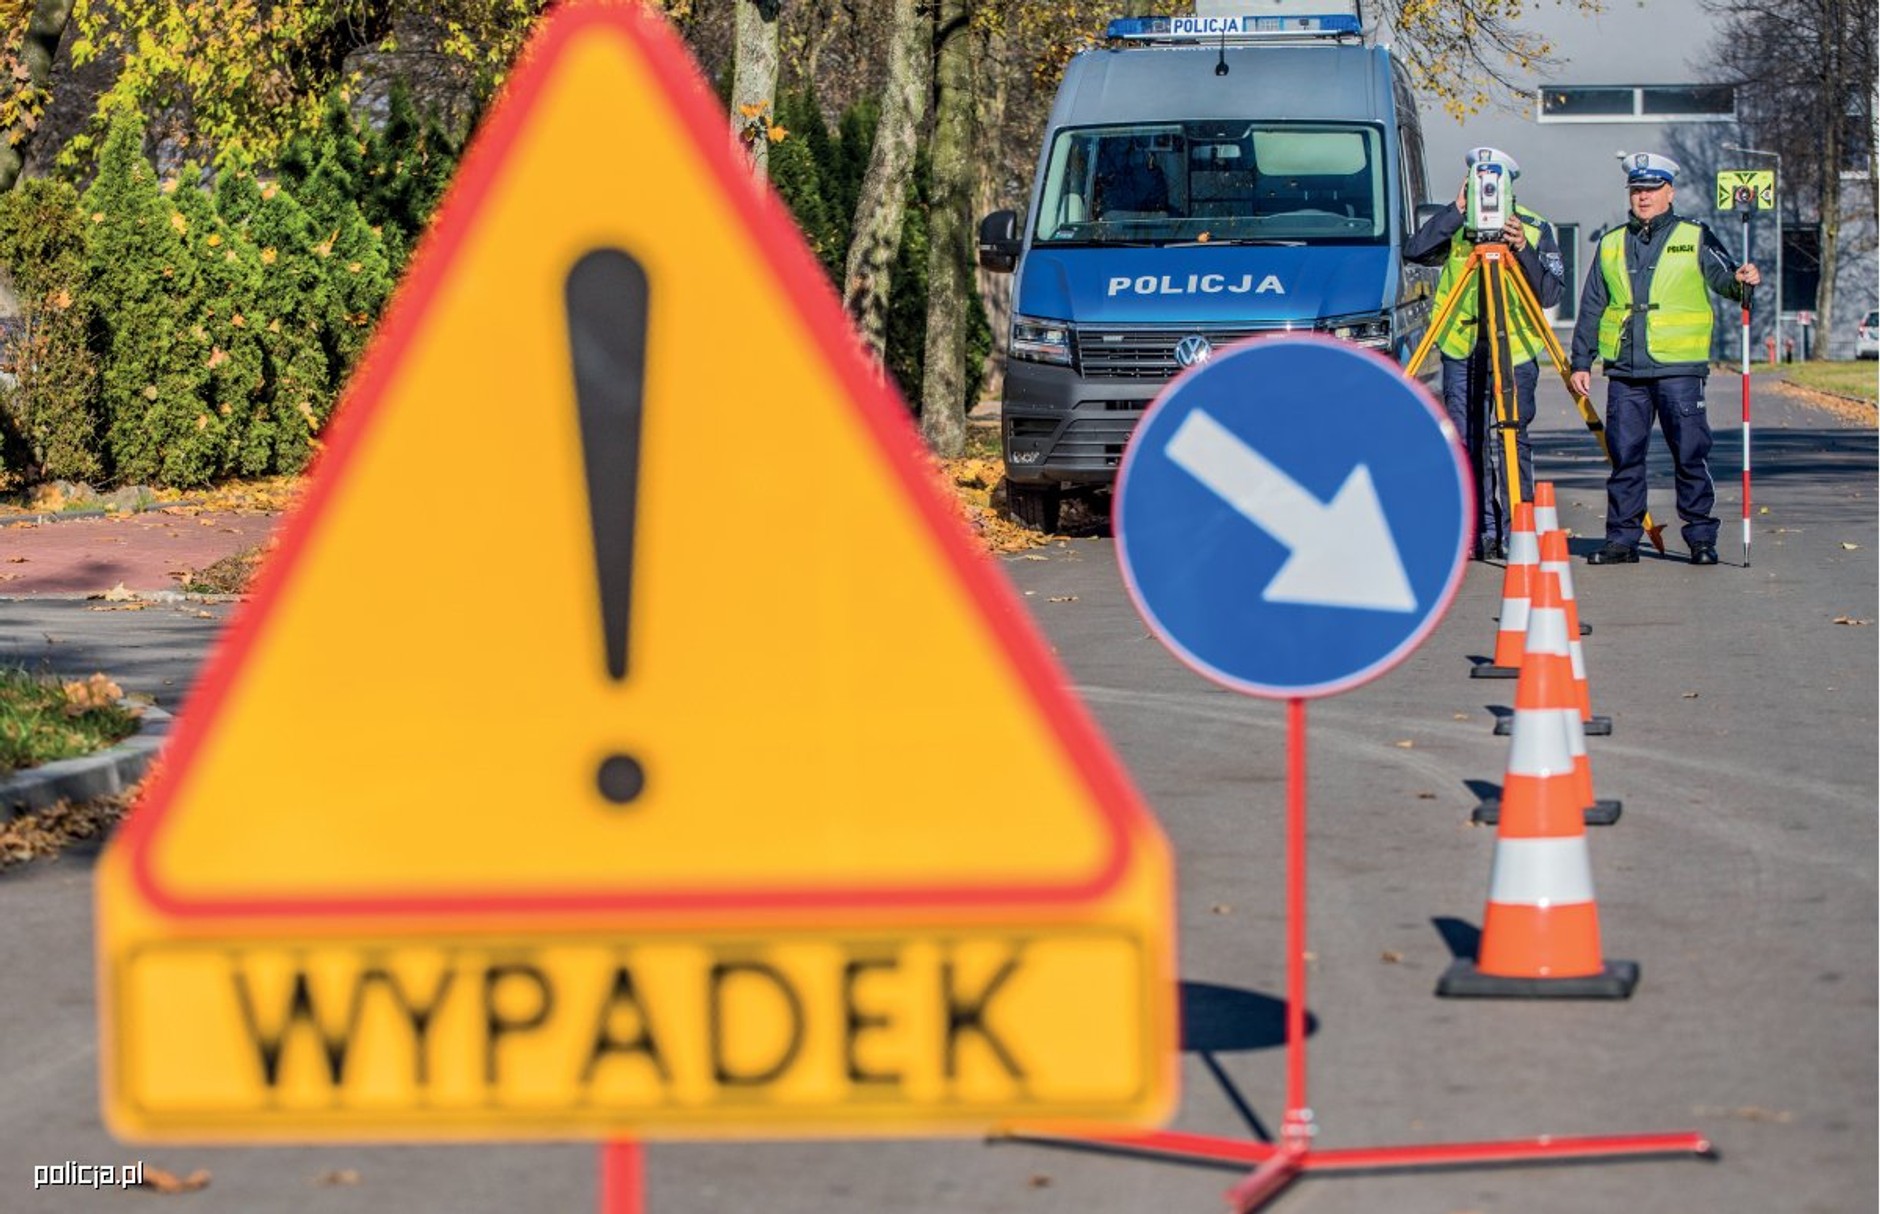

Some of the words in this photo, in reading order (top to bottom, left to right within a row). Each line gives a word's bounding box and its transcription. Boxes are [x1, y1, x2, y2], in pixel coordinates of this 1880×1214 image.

[1173, 18, 1239, 34] POLICJA
[1107, 274, 1286, 296] POLICJA
[231, 958, 1027, 1089] WYPADEK
